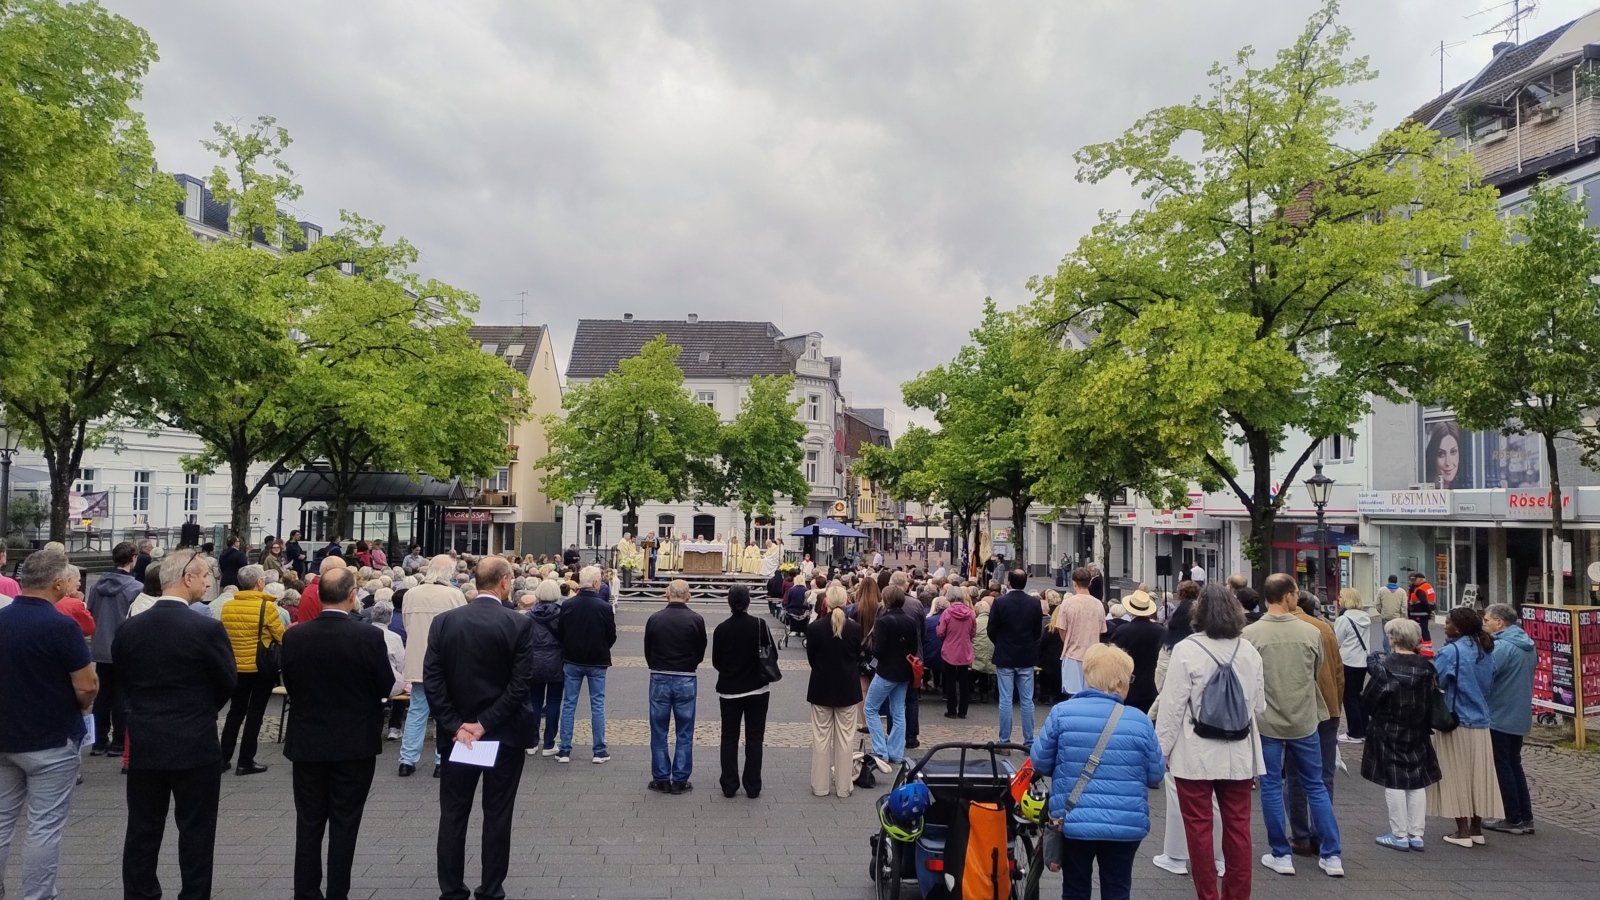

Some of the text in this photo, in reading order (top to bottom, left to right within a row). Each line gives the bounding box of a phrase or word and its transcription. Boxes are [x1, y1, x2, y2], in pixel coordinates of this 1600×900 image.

[1391, 492, 1446, 505] BESTMANN
[1509, 492, 1570, 508] Röselr
[1522, 607, 1571, 625] SIEG BURGER
[1579, 612, 1590, 625] SIEG
[1523, 620, 1571, 643] WEINFEST
